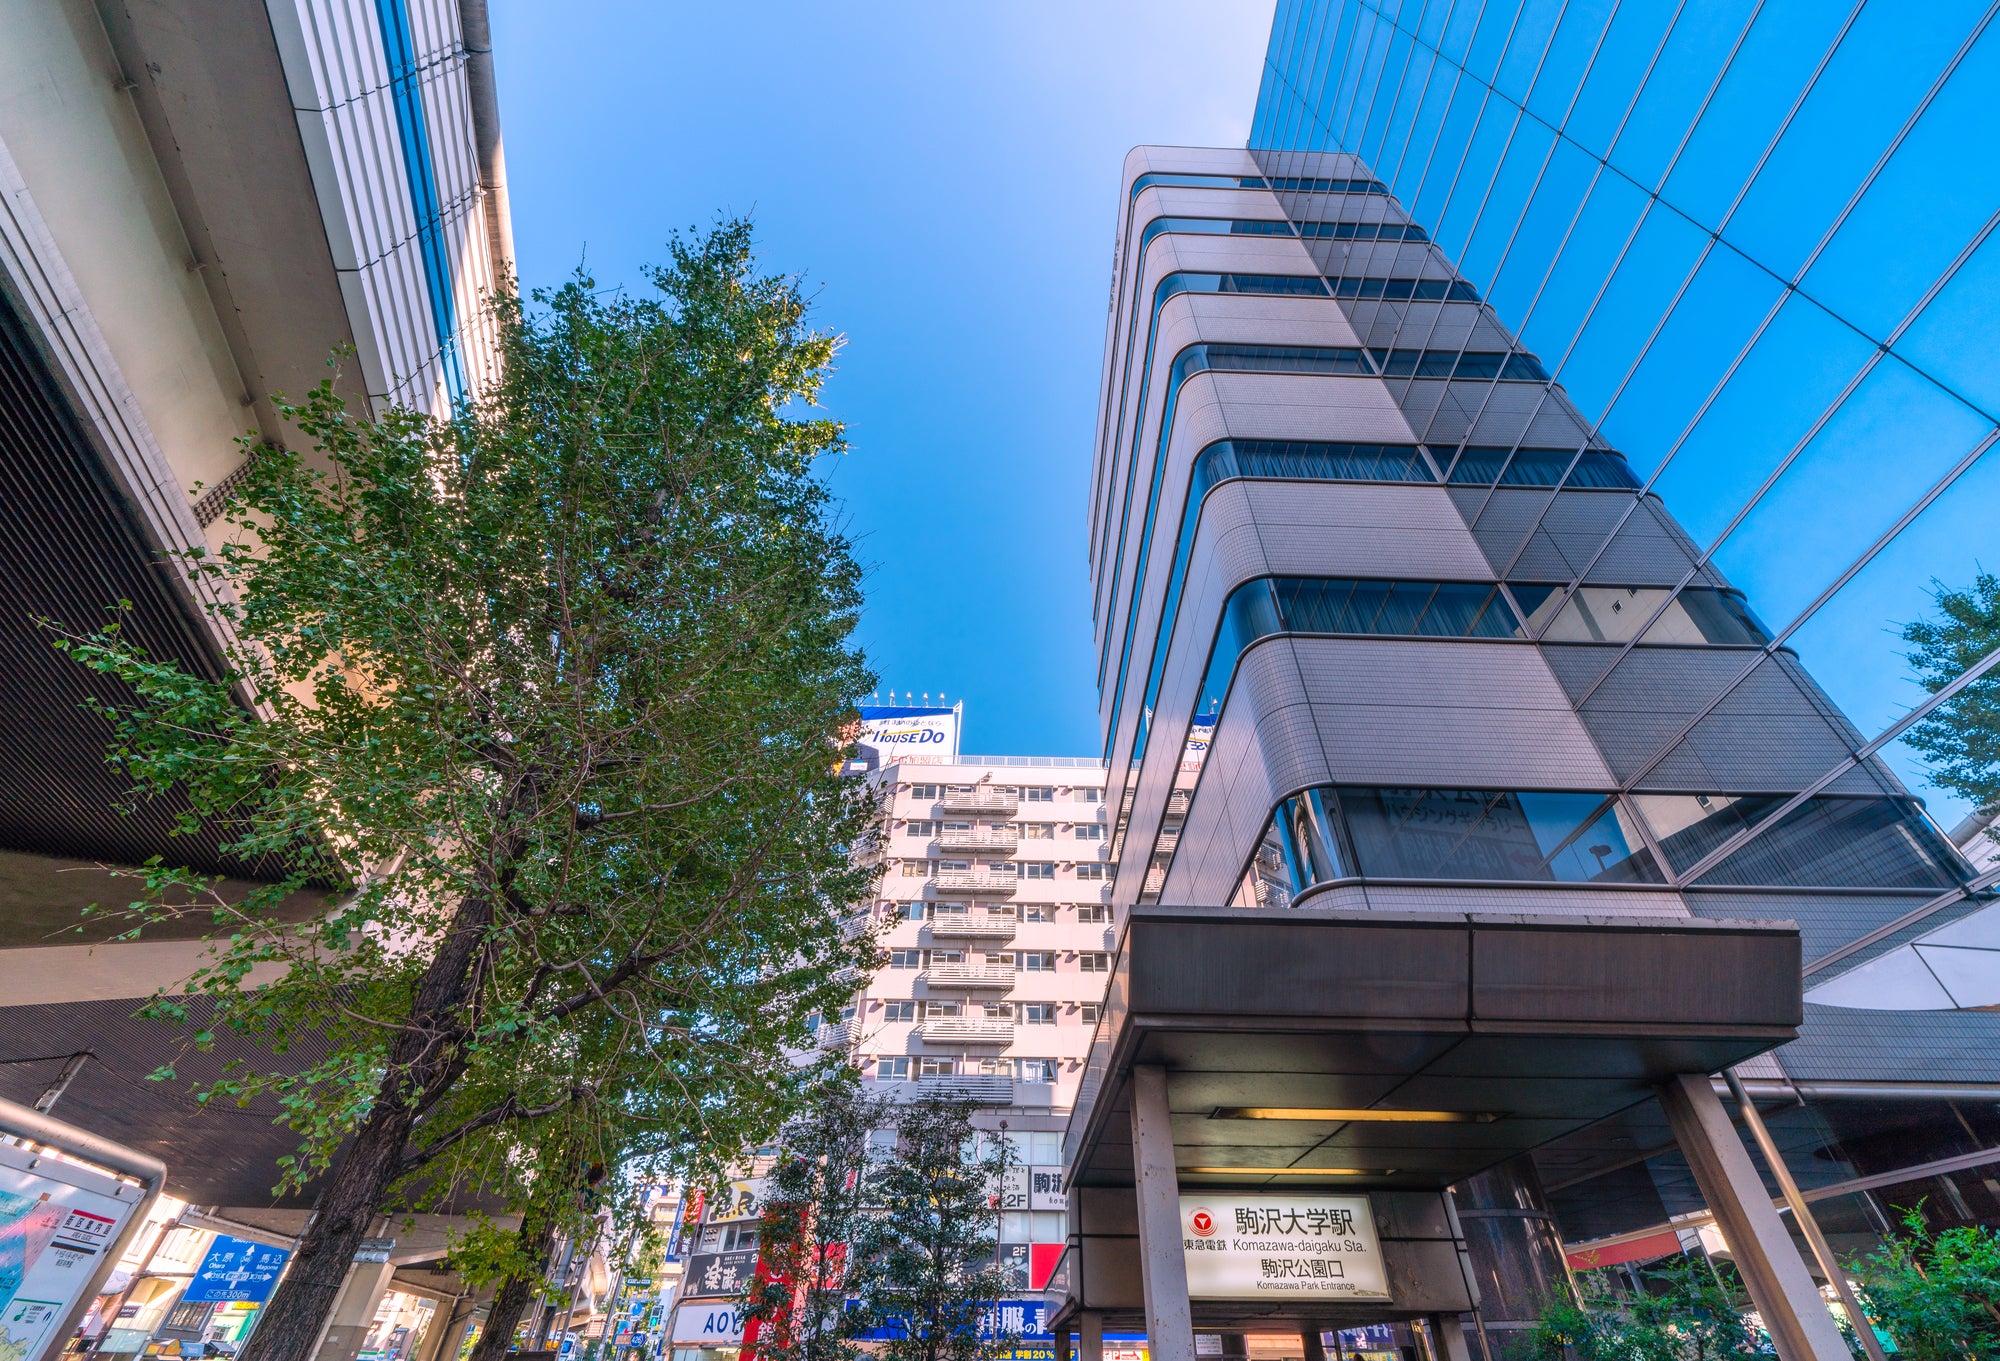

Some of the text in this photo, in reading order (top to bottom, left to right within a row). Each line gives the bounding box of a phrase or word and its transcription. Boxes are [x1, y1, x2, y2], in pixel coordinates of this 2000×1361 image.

[1006, 1194, 1026, 1207] 2F
[1234, 1207, 1356, 1236] 駒沢大学駅
[1183, 1239, 1227, 1250] 東急電鉄
[1233, 1239, 1367, 1254] Komazawa-daigaku Sta.
[1012, 1247, 1026, 1256] 2F
[1261, 1258, 1345, 1279] 駒沢公園口
[1257, 1281, 1356, 1291] Komazawa Park Entrance
